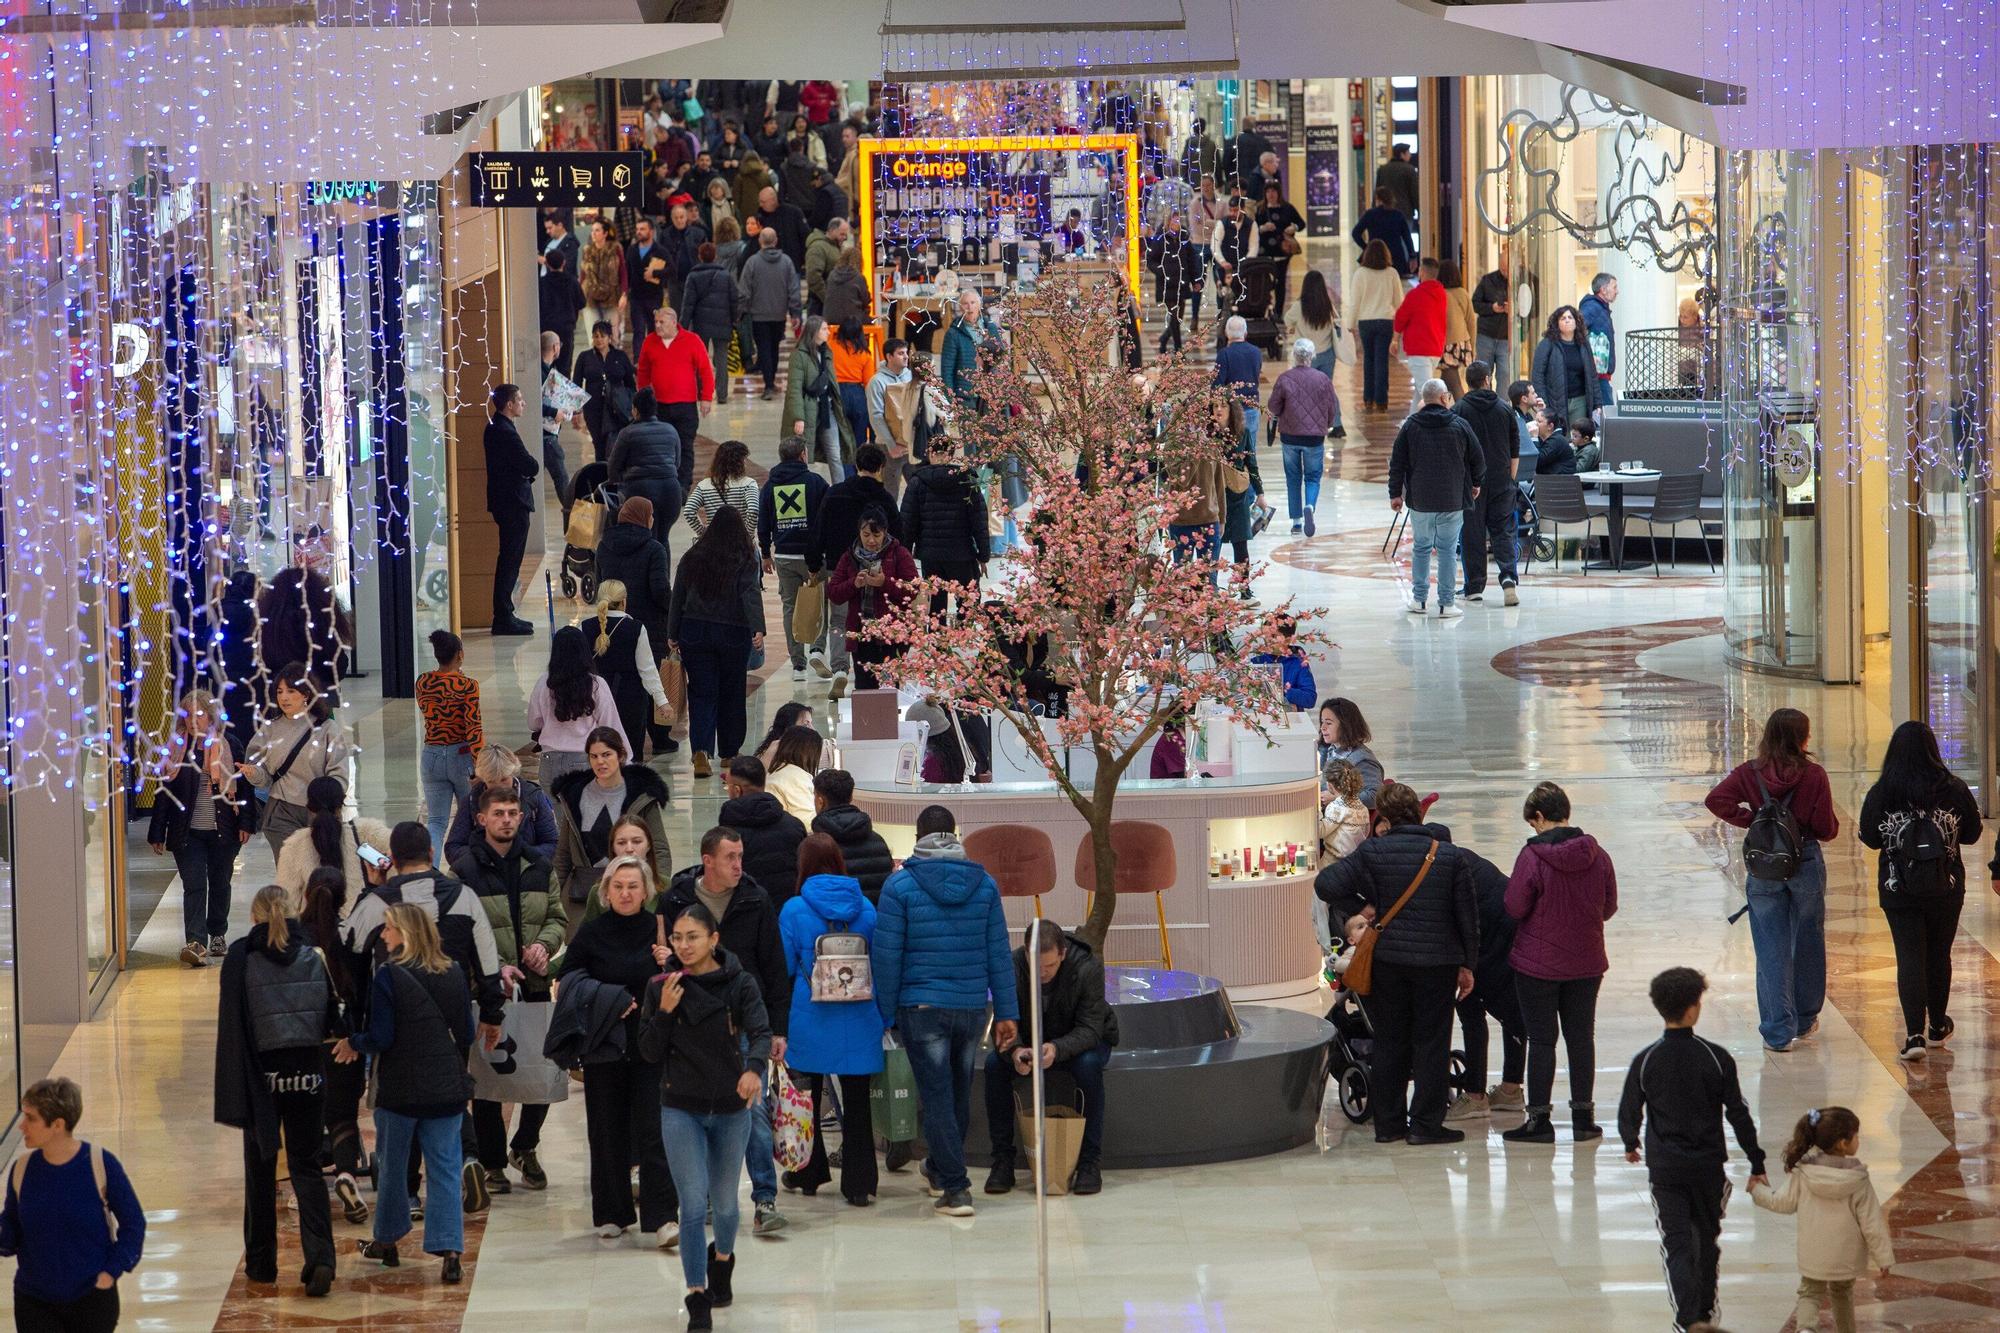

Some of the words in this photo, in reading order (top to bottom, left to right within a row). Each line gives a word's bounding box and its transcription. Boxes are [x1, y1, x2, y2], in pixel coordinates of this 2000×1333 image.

[893, 159, 966, 179] Orange
[530, 177, 550, 188] WC
[987, 190, 1037, 208] Todo
[1621, 404, 1662, 413] RESERVADO
[1664, 405, 1696, 414] CLIENTES
[264, 1070, 323, 1095] Juicy
